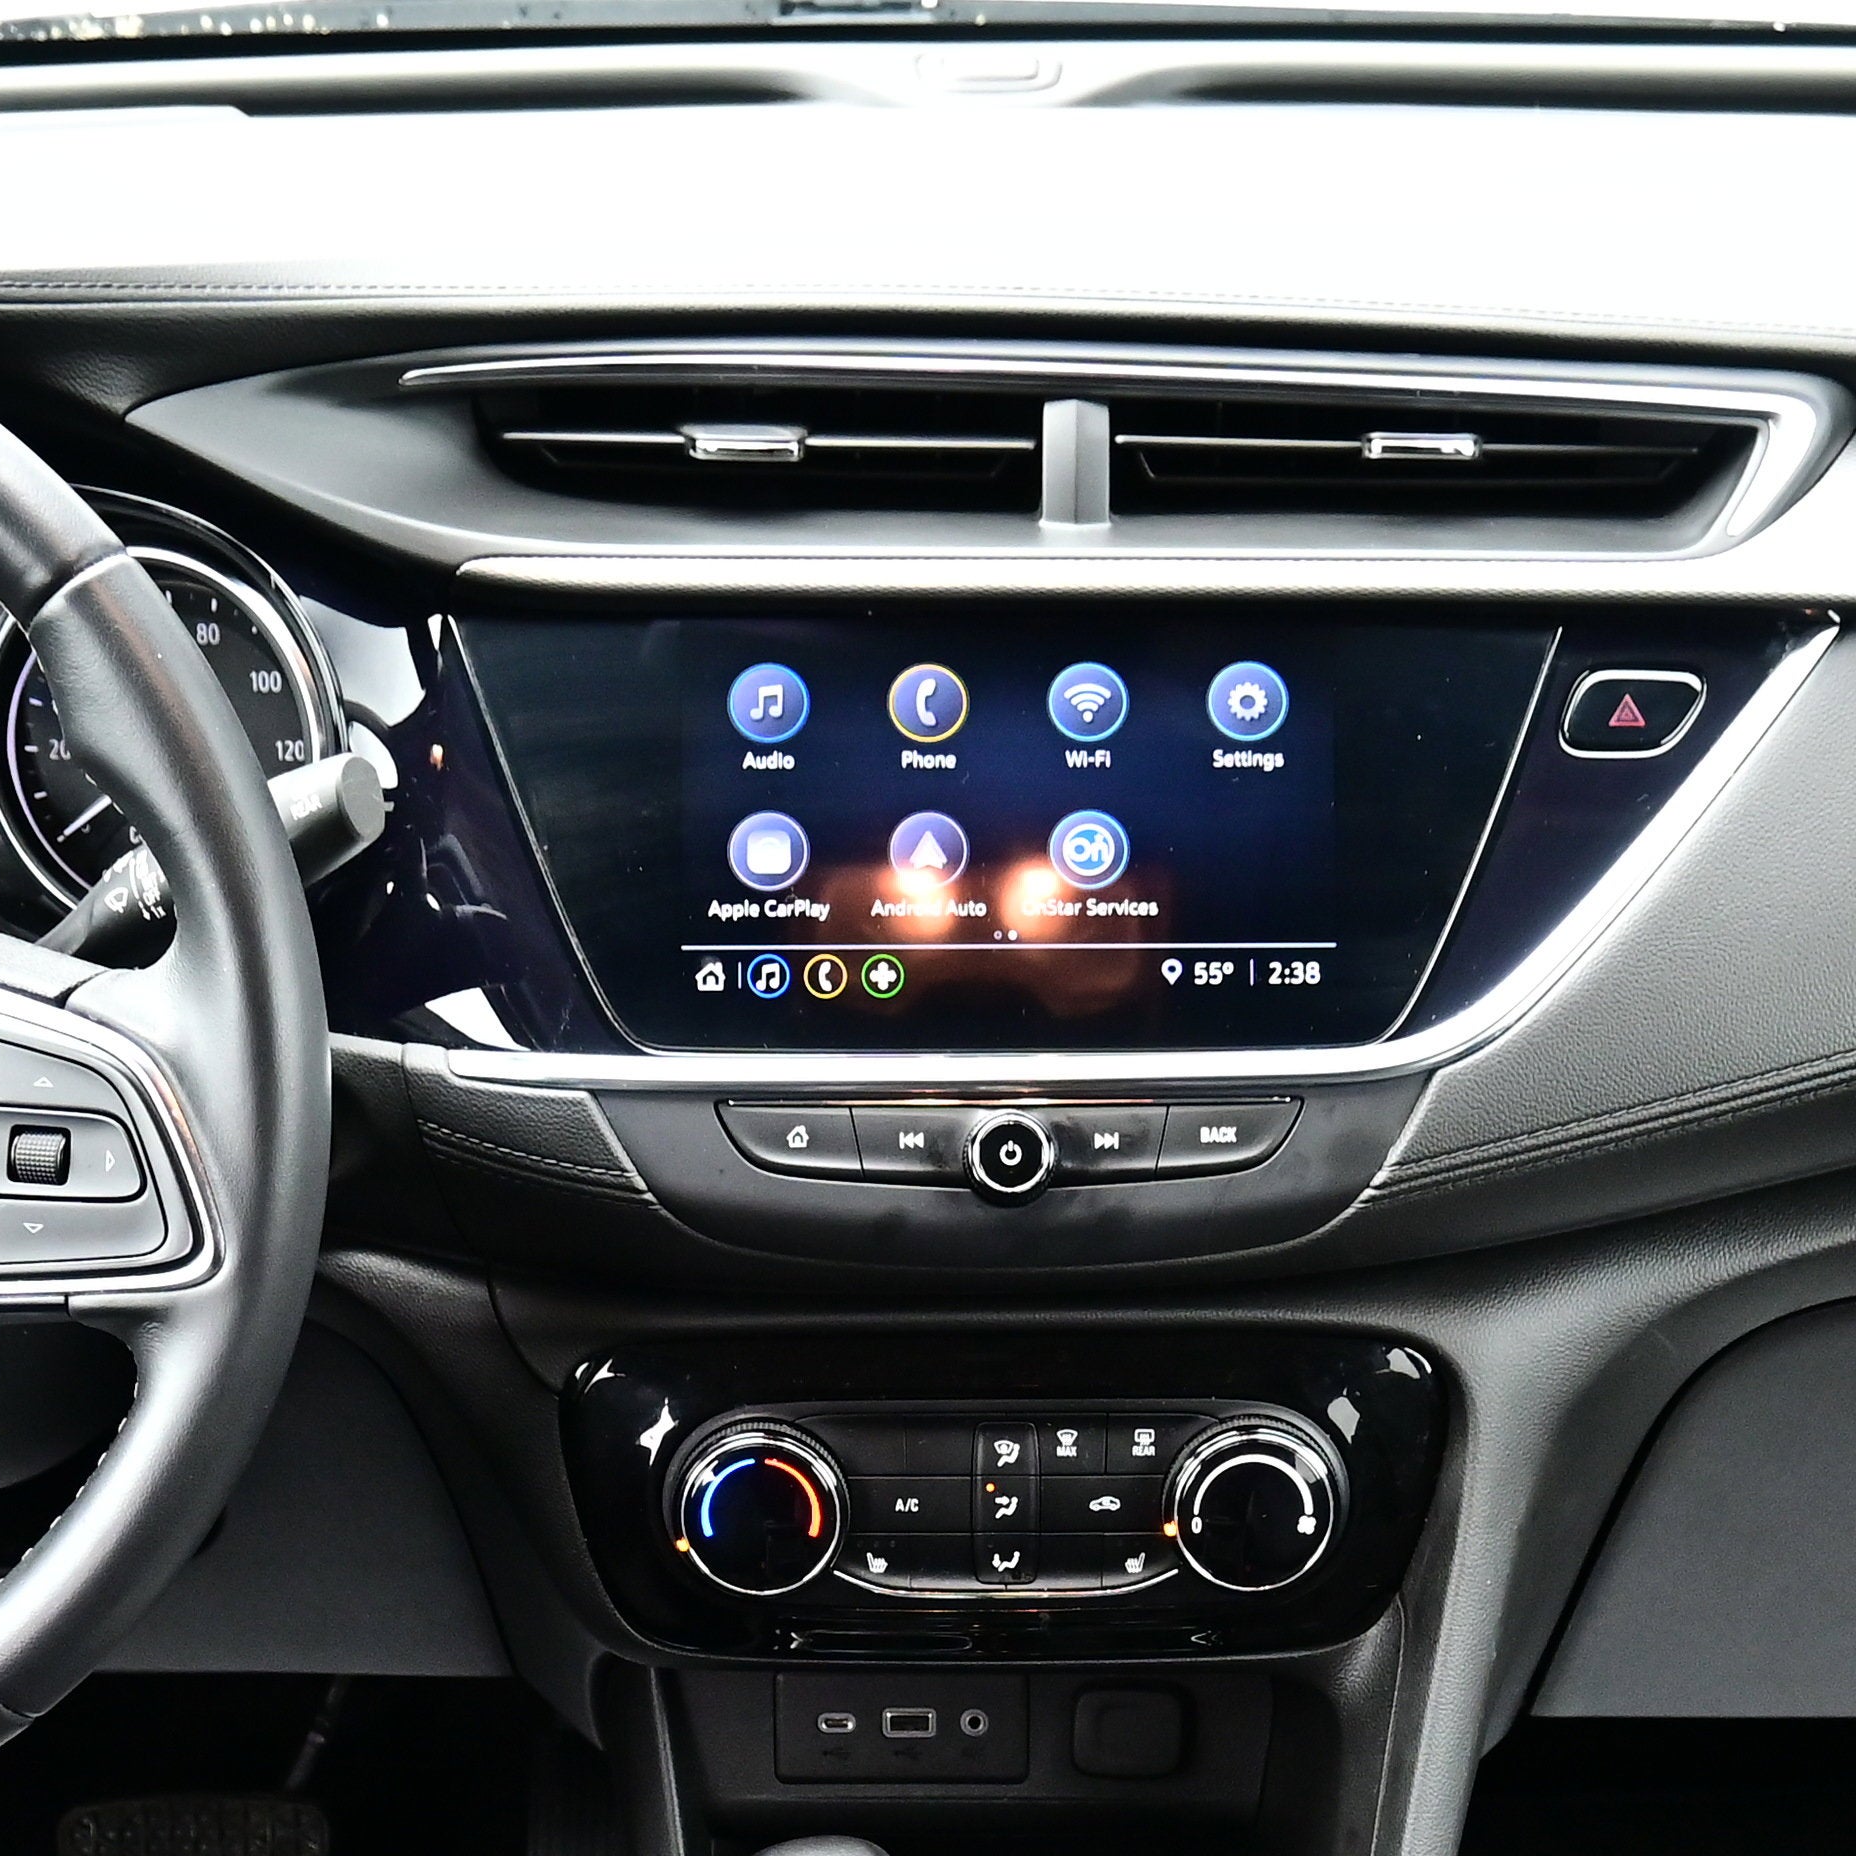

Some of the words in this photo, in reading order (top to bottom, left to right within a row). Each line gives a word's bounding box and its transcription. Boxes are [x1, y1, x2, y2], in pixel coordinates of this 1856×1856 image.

[196, 622, 221, 646] 80
[249, 670, 283, 693] 100
[274, 739, 305, 762] 120
[742, 750, 796, 771] Audio
[900, 750, 958, 770] Phone
[1065, 749, 1112, 769] Wi-Fi
[1212, 748, 1285, 771] Settings
[707, 899, 760, 922] Apple
[763, 899, 831, 923] CarPlay
[945, 899, 988, 918] Auto
[1086, 897, 1160, 917] Services
[1193, 961, 1234, 985] 55°
[1268, 961, 1321, 985] 2:38
[1199, 1126, 1238, 1144] BACK
[1056, 1446, 1078, 1457] MAX
[1131, 1445, 1156, 1457] REAR
[894, 1498, 920, 1513] A/C
